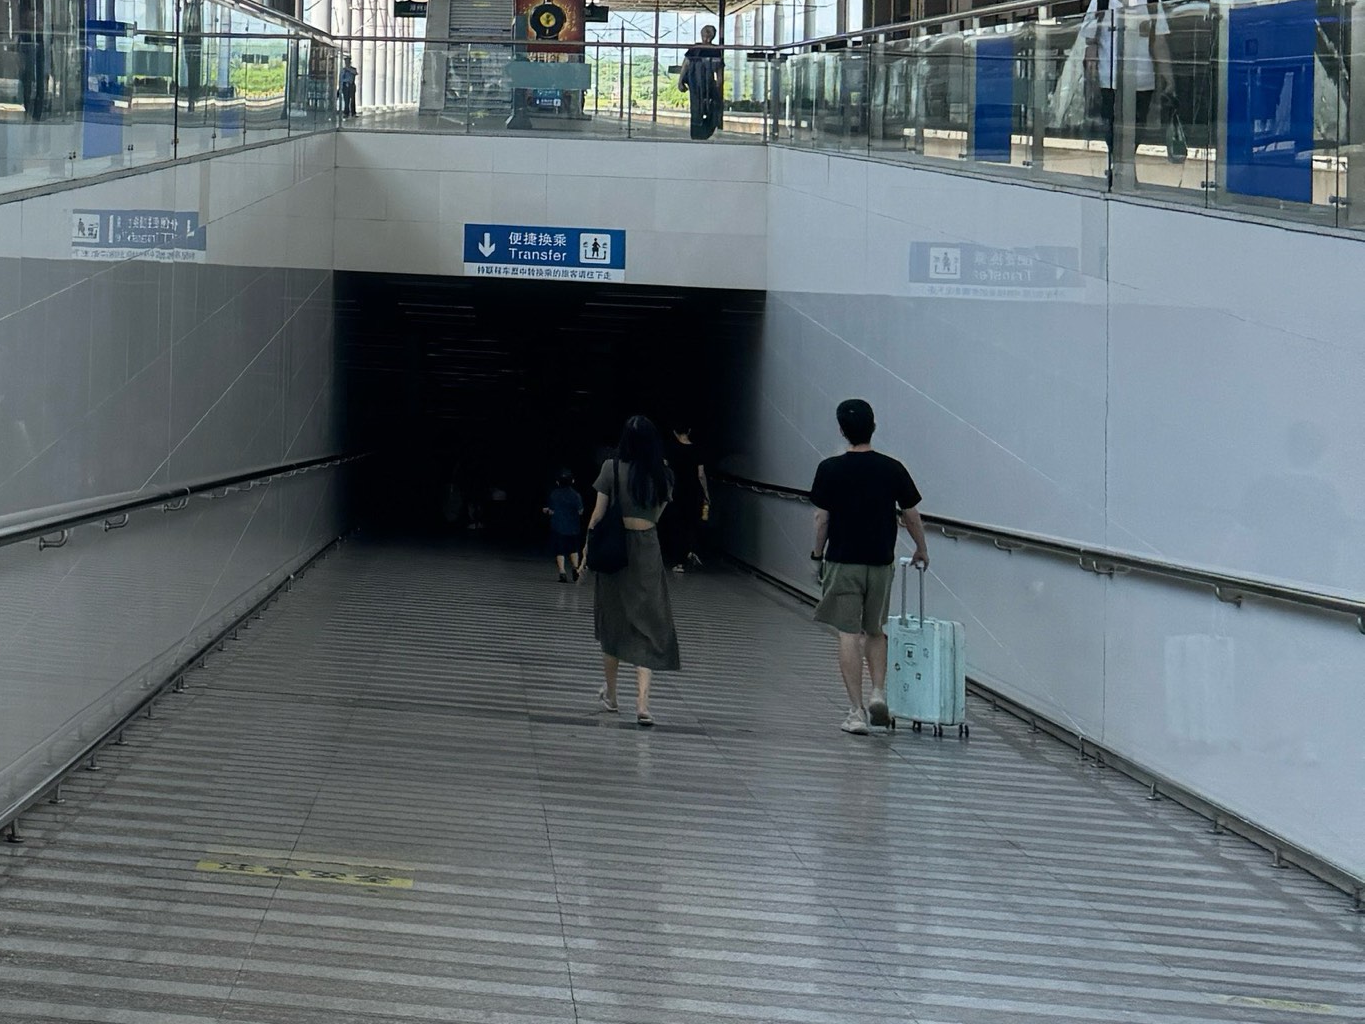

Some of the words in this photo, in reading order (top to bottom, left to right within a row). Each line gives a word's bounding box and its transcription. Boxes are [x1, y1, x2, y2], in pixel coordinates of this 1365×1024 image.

[508, 231, 567, 247] 便捷换乘
[508, 247, 567, 262] Transfer
